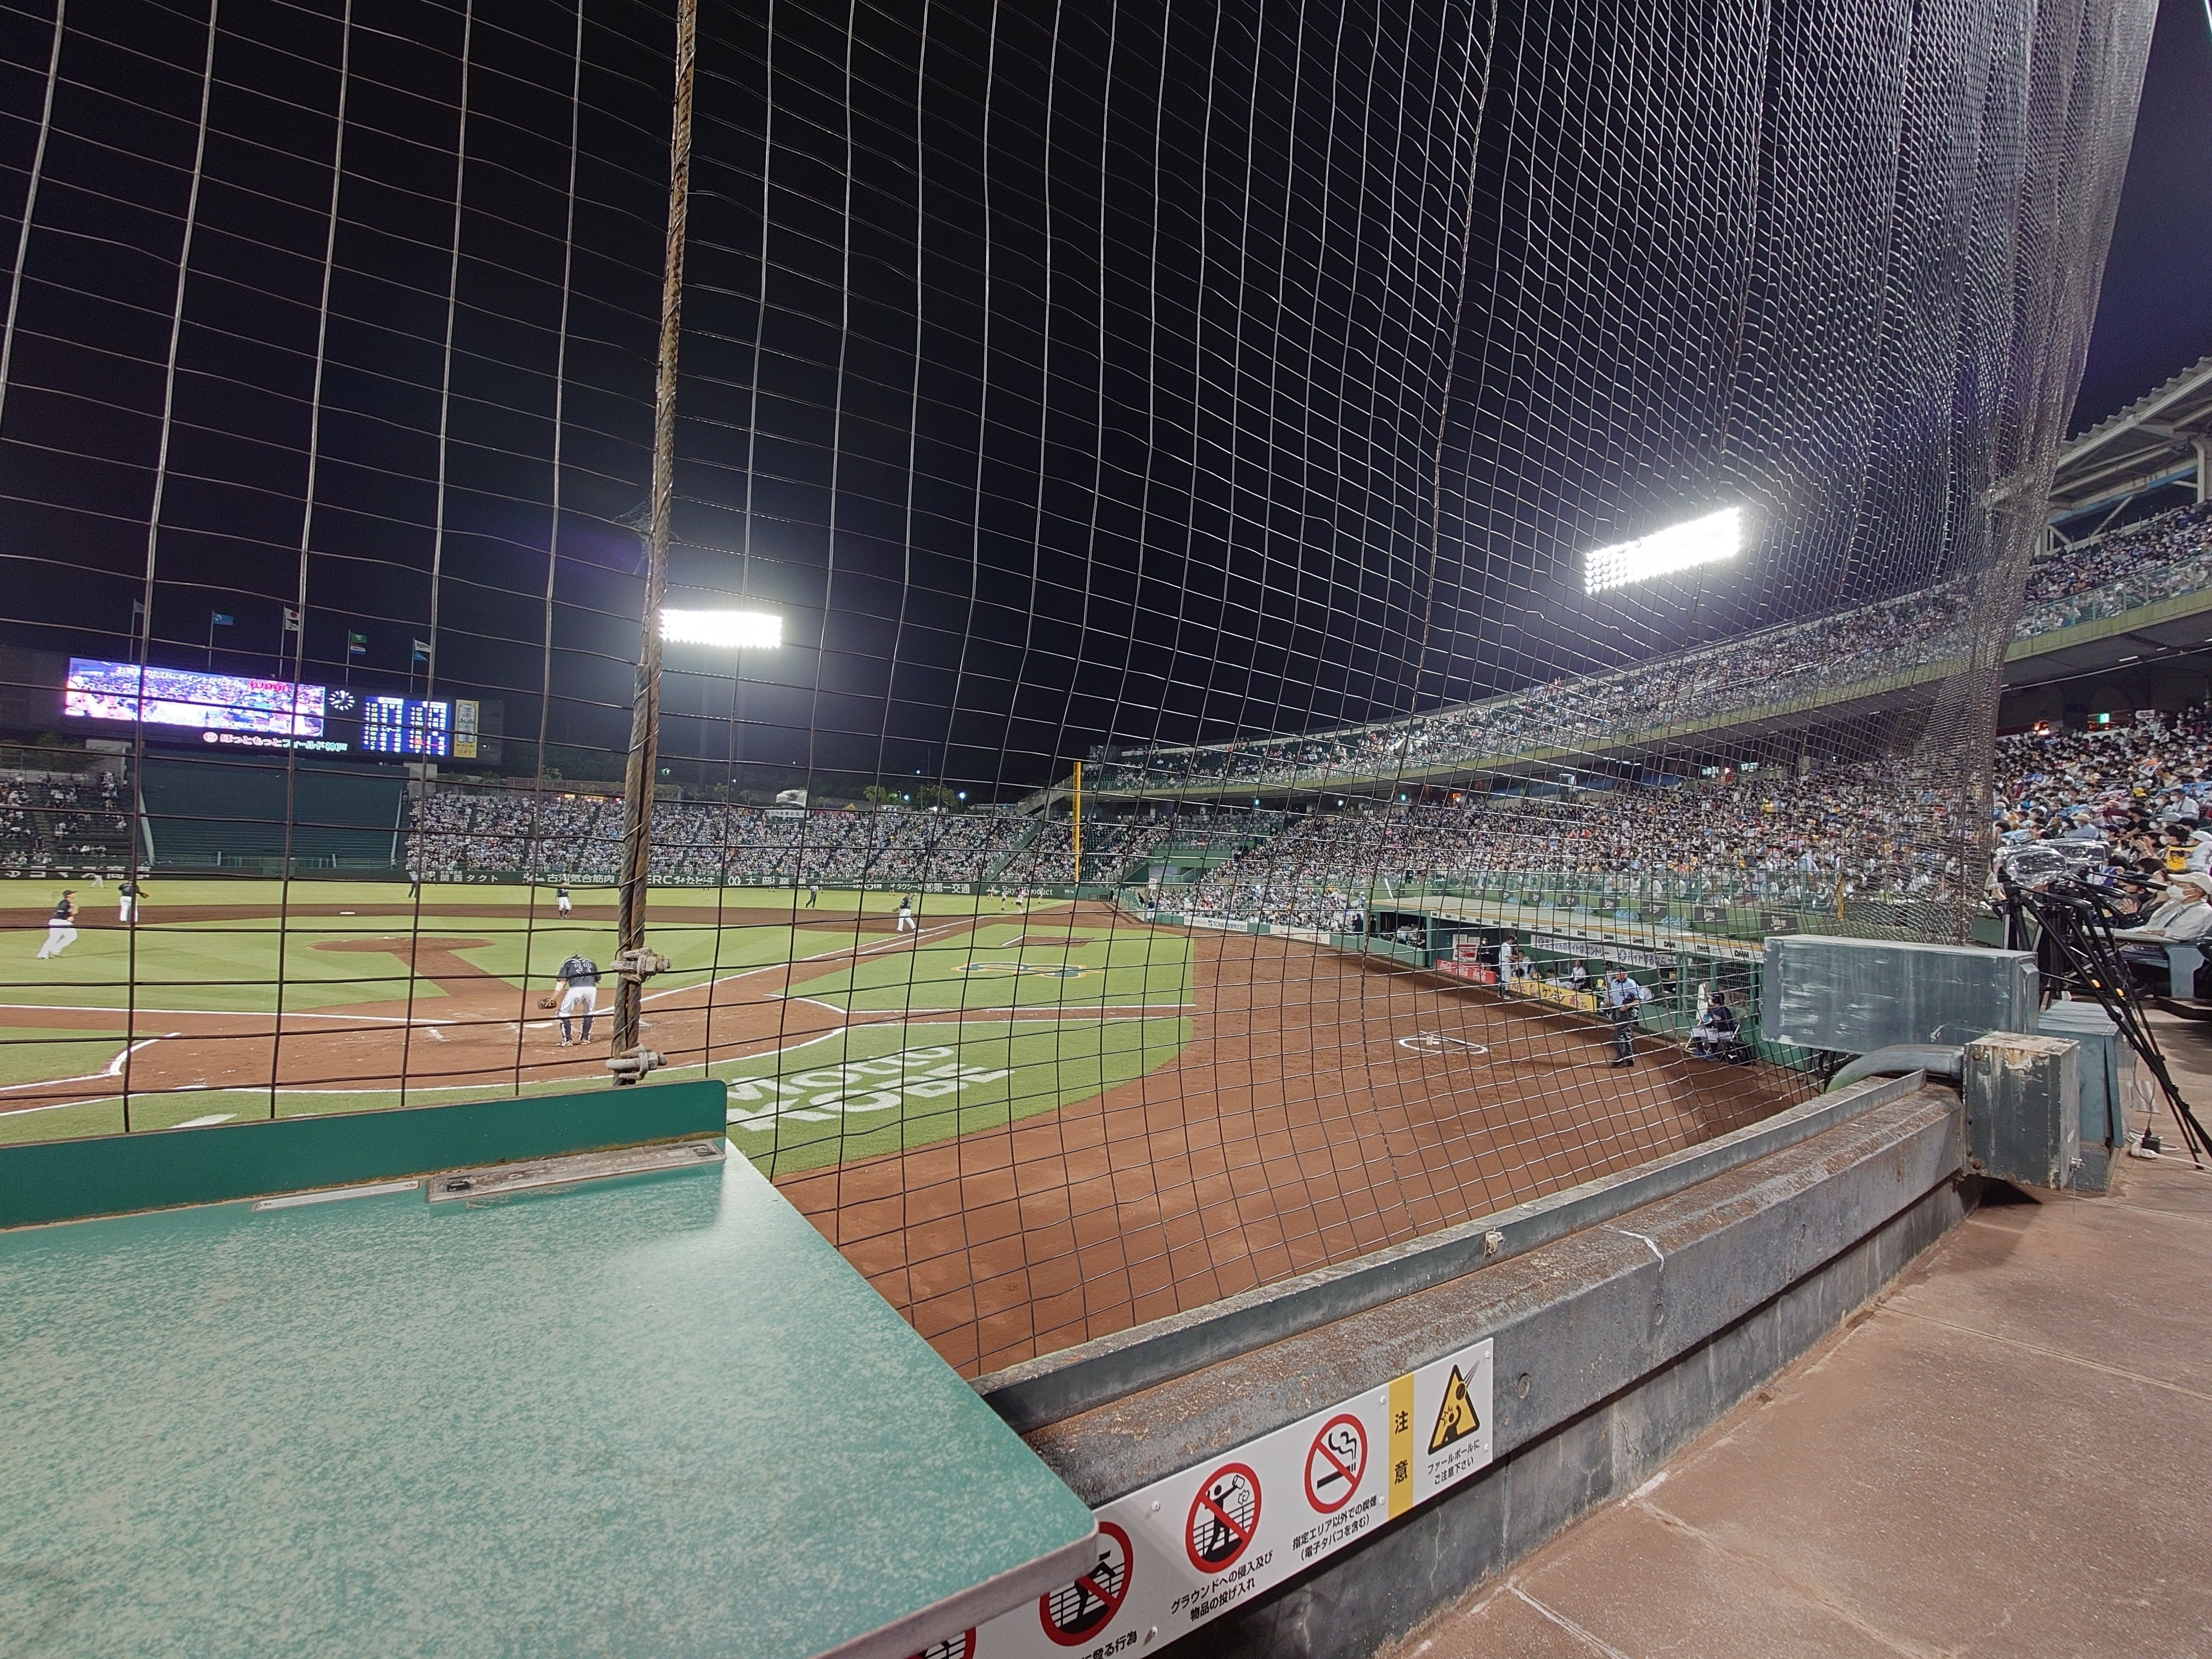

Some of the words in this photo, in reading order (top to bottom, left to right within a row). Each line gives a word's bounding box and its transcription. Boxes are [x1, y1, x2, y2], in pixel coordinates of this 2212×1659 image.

[220, 733, 348, 752] ほっともっとフィールド神戸
[440, 873, 499, 883] 関西タクト
[933, 883, 970, 894] 第一交通
[1734, 950, 1750, 958] DMM
[727, 1063, 1015, 1132] KOBE
[1427, 1439, 1480, 1475] ファールボールに
[1434, 1457, 1474, 1485] ご注意下さい
[1293, 1494, 1378, 1551] 指定エリア以外での喫煙
[1171, 1549, 1273, 1615] グラウンドへの侵入及び
[1190, 1577, 1255, 1622] 物品の投げ入れ
